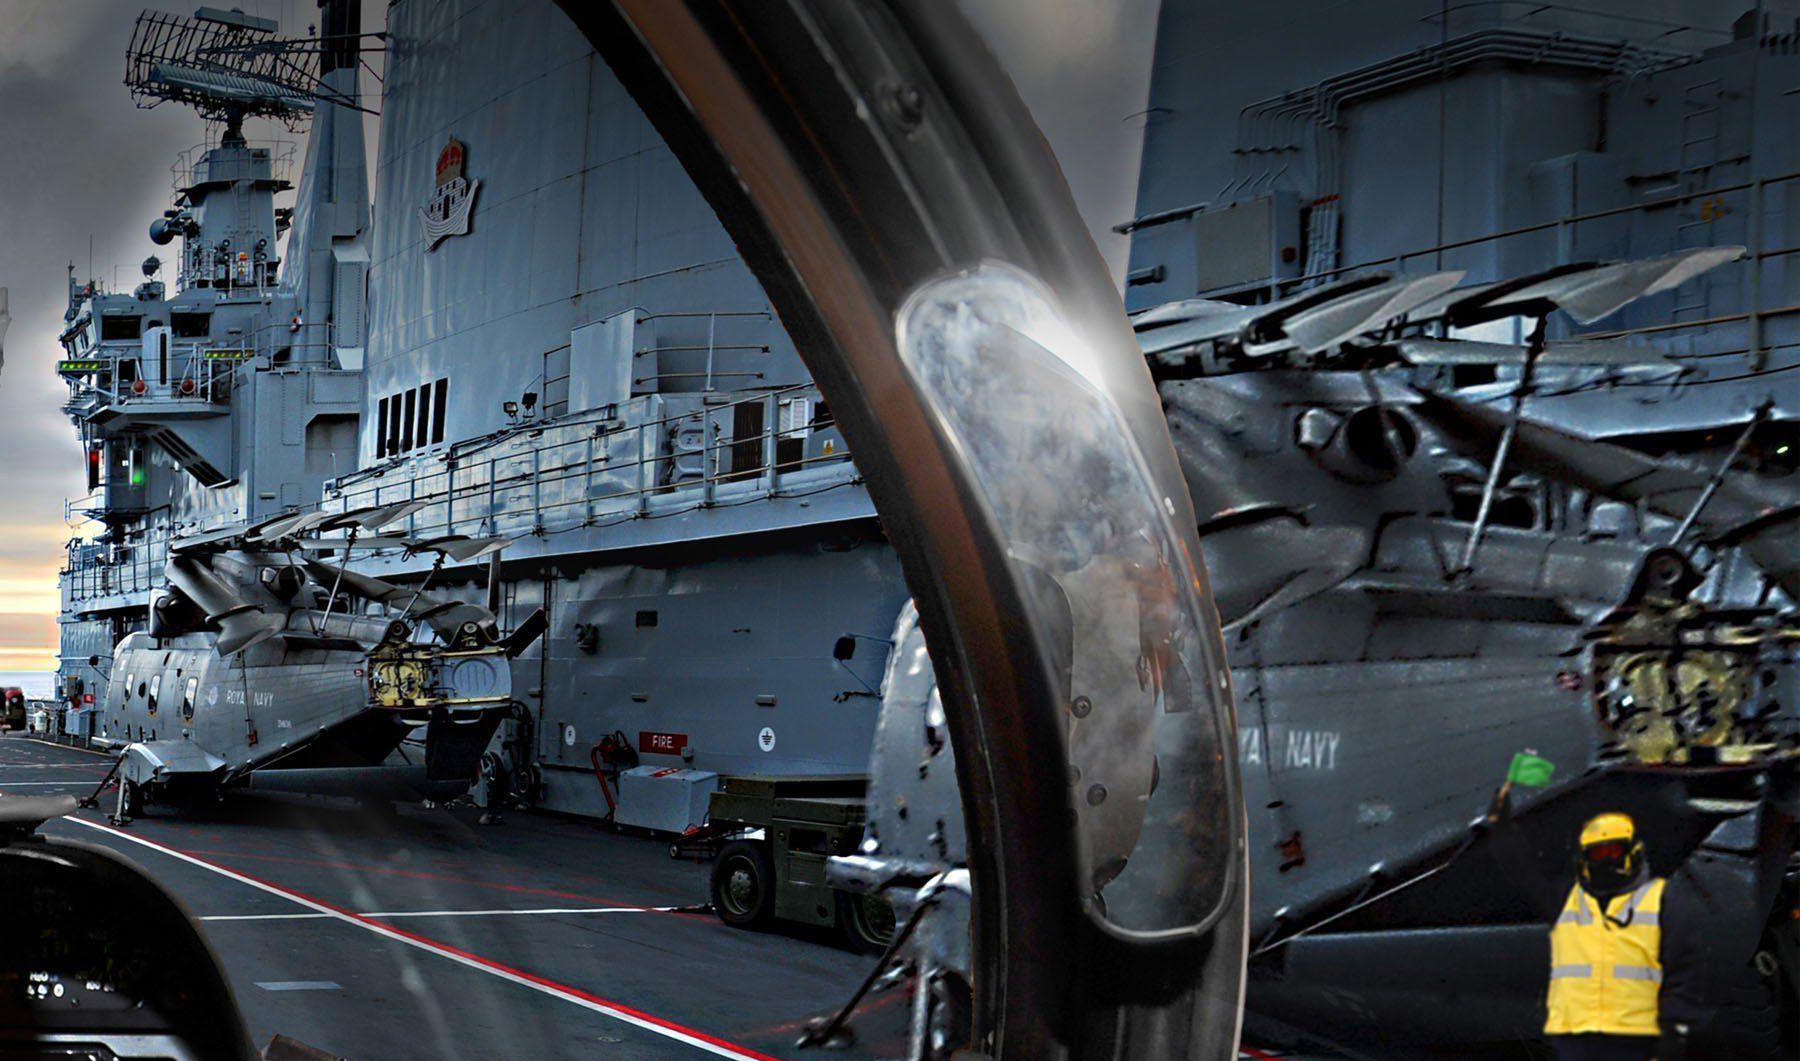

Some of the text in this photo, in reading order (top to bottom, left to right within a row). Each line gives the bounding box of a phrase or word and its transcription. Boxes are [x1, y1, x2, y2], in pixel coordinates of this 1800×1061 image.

[253, 691, 274, 707] NAVY
[652, 735, 674, 749] FIRE
[1286, 730, 1340, 770] NAVY
